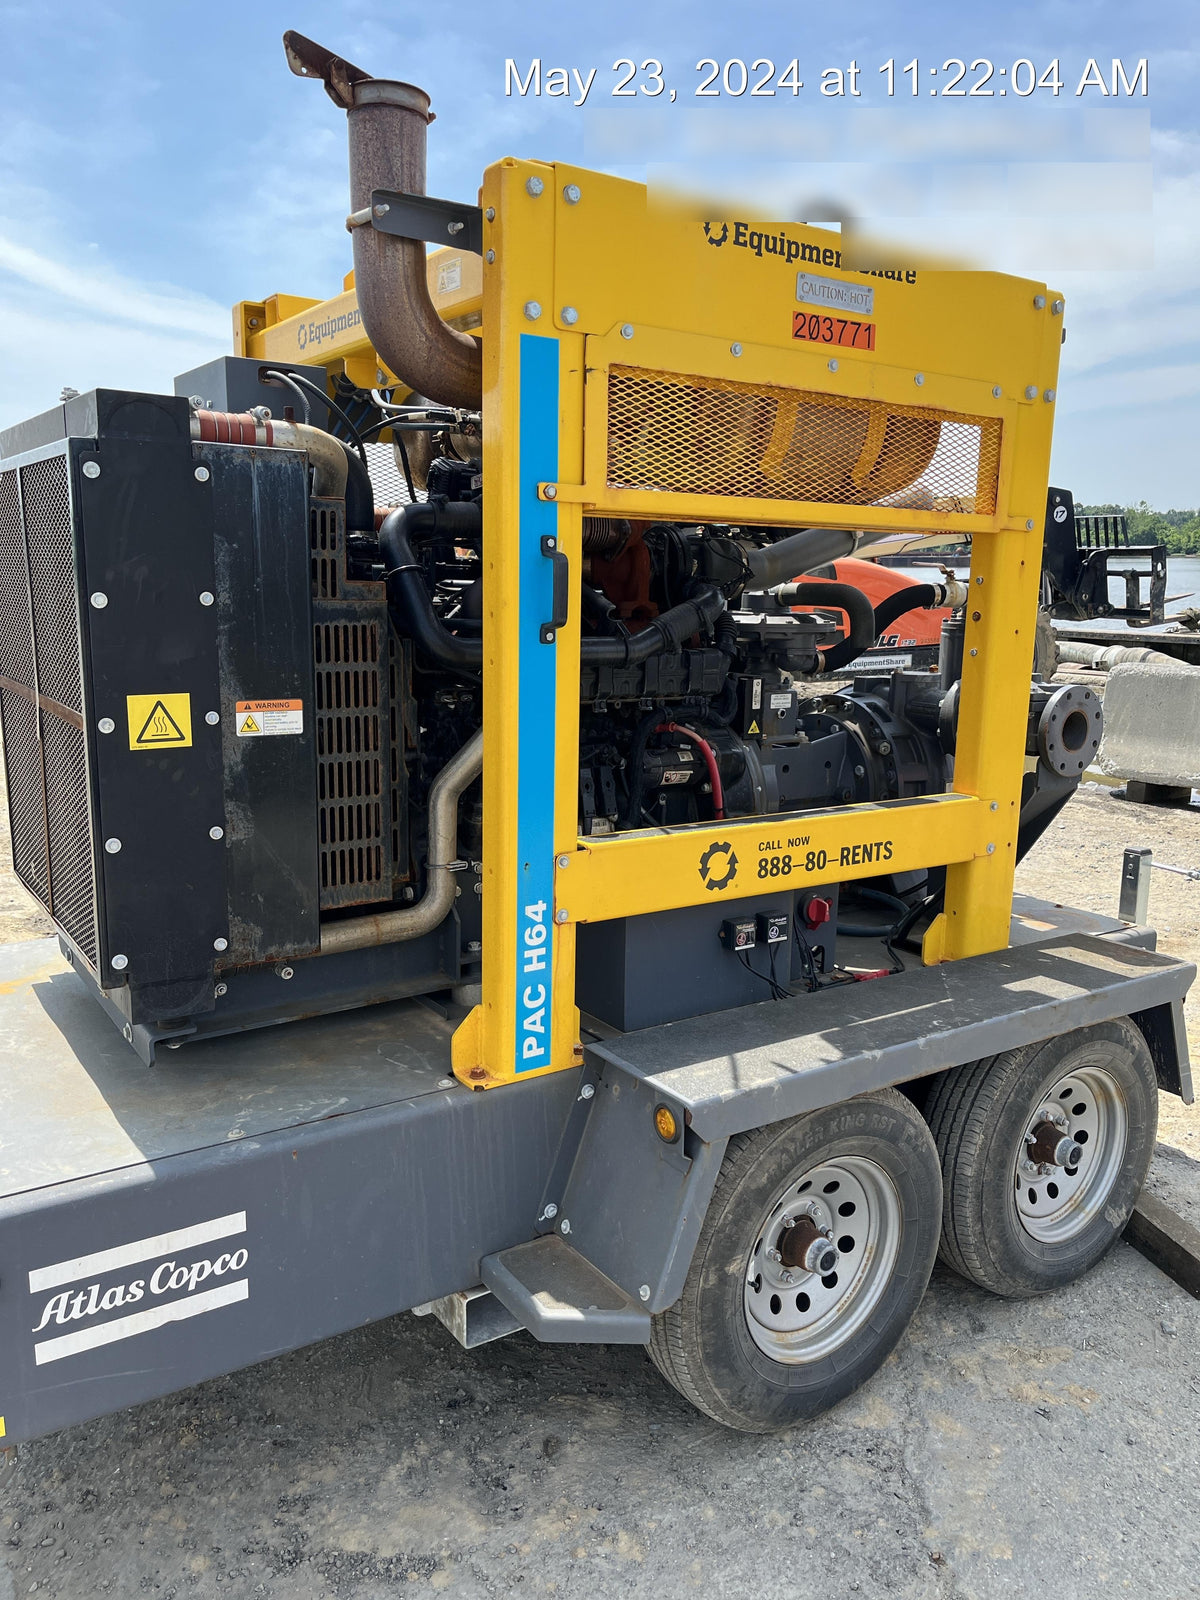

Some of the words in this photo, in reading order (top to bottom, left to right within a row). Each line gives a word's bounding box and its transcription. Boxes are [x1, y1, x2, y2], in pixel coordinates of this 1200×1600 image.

[801, 281, 847, 302] CAUTION:
[850, 292, 870, 306] HOT
[793, 312, 872, 349] 203771
[1055, 510, 1066, 519] 17
[877, 634, 900, 648] LG
[254, 701, 290, 709] WARNING
[758, 839, 783, 852] CALL
[787, 836, 810, 848] NOW
[523, 900, 547, 973] H64
[523, 983, 546, 1059] PAC
[829, 1112, 866, 1135] KING
[32, 1280, 146, 1333] Atlas
[149, 1248, 249, 1295] Copco
